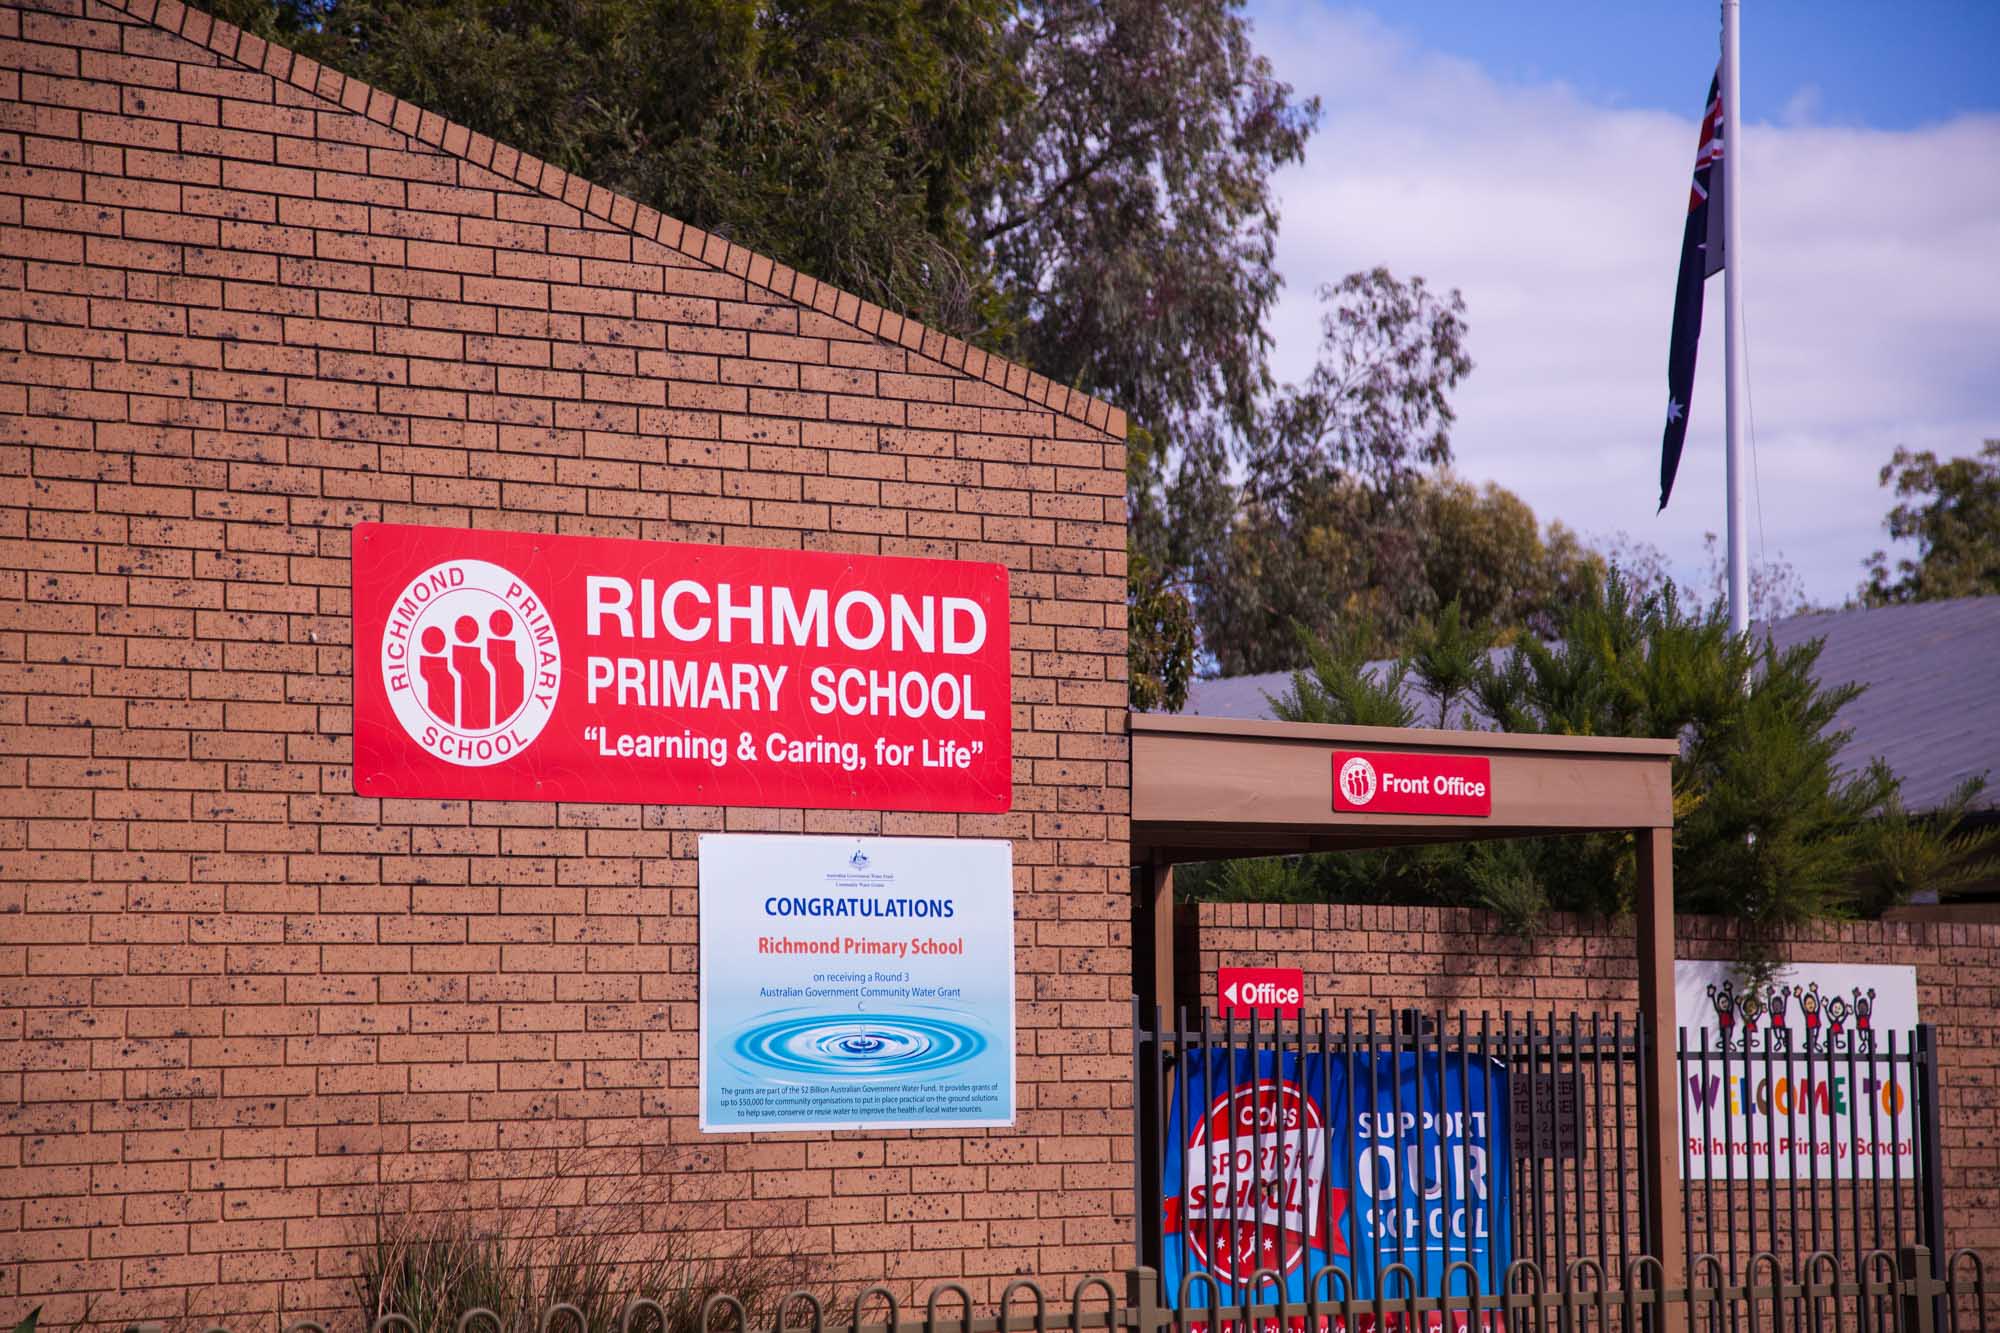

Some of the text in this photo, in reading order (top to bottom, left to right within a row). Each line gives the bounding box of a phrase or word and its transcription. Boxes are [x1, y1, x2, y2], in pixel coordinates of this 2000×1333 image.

[586, 575, 987, 655] RICHMOND
[387, 567, 557, 710] RICHMOND PRIMARY
[587, 656, 986, 721] PRIMARY SCHOOL
[422, 726, 528, 760] SCHOOL
[736, 731, 758, 762] &
[765, 732, 867, 771] Caring,
[874, 737, 914, 767] for
[1382, 773, 1429, 794] Front
[1433, 776, 1486, 797] Office
[765, 897, 954, 918] CONGRATULATIONS
[758, 936, 963, 958] Richmond Primary School
[813, 972, 910, 984] on receiving a Round 3
[760, 987, 961, 998] Australian Government Community Water Grant
[1241, 982, 1299, 1004] Office
[720, 1099, 729, 1107] up
[775, 1097, 811, 1106] community
[812, 1097, 854, 1106] organisations
[863, 1096, 873, 1105] put
[881, 1096, 899, 1105] place
[900, 1095, 925, 1104] practical
[971, 1094, 998, 1102] solutions
[721, 1087, 733, 1095] The
[734, 1087, 754, 1097] grants
[767, 1087, 780, 1097] part
[781, 1086, 788, 1094] of
[789, 1086, 800, 1094] the
[810, 1085, 830, 1094] Billion
[831, 1085, 861, 1093] Australian
[862, 1085, 901, 1094] Government
[902, 1085, 920, 1093] Water
[945, 1083, 970, 1093] provides
[971, 1084, 991, 1093] grants
[738, 1109, 745, 1117] to
[746, 1109, 760, 1118] help
[778, 1109, 804, 1117] conserve
[833, 1108, 851, 1116] water
[859, 1106, 885, 1115] improve
[886, 1106, 896, 1114] the
[897, 1106, 917, 1114] health
[925, 1105, 940, 1113] local
[1358, 1112, 1488, 1138] SUPPORT
[1358, 1145, 1489, 1200] OUR
[1366, 1207, 1489, 1238] SCHOOL
